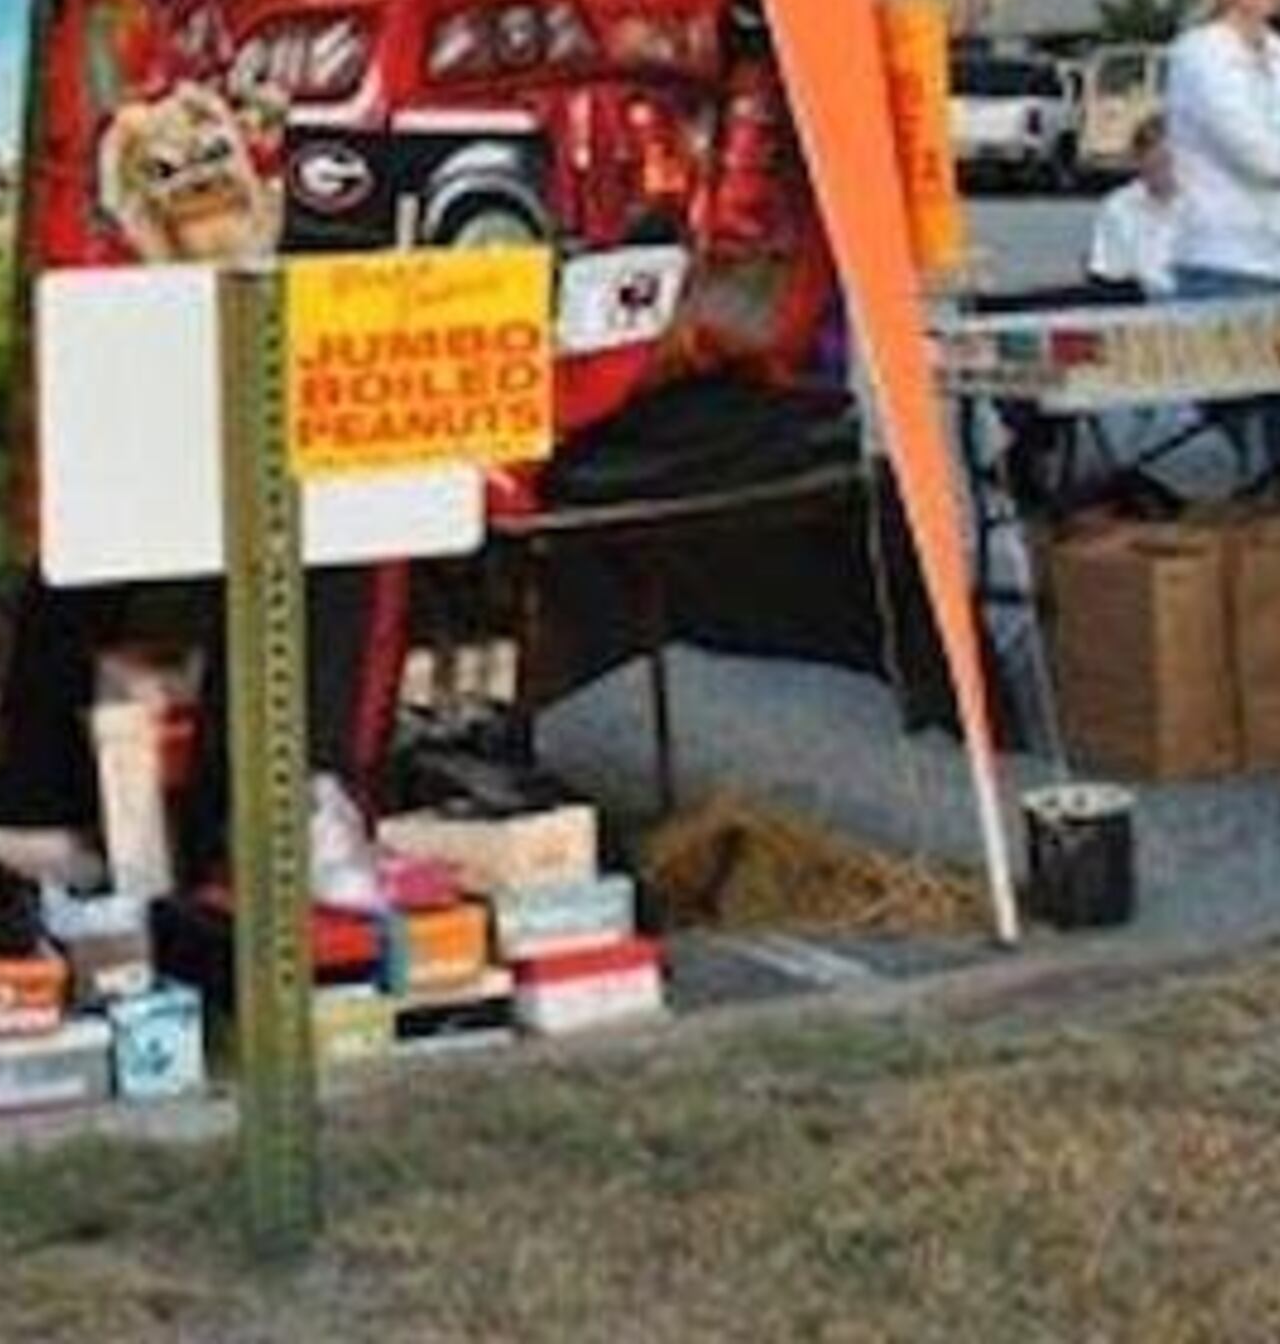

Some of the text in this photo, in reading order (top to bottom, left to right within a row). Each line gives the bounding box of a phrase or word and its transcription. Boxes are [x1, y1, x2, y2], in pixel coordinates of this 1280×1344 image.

[297, 320, 540, 369] JUMBO
[301, 359, 540, 408] BOILED
[296, 398, 541, 448] PEANUTS
